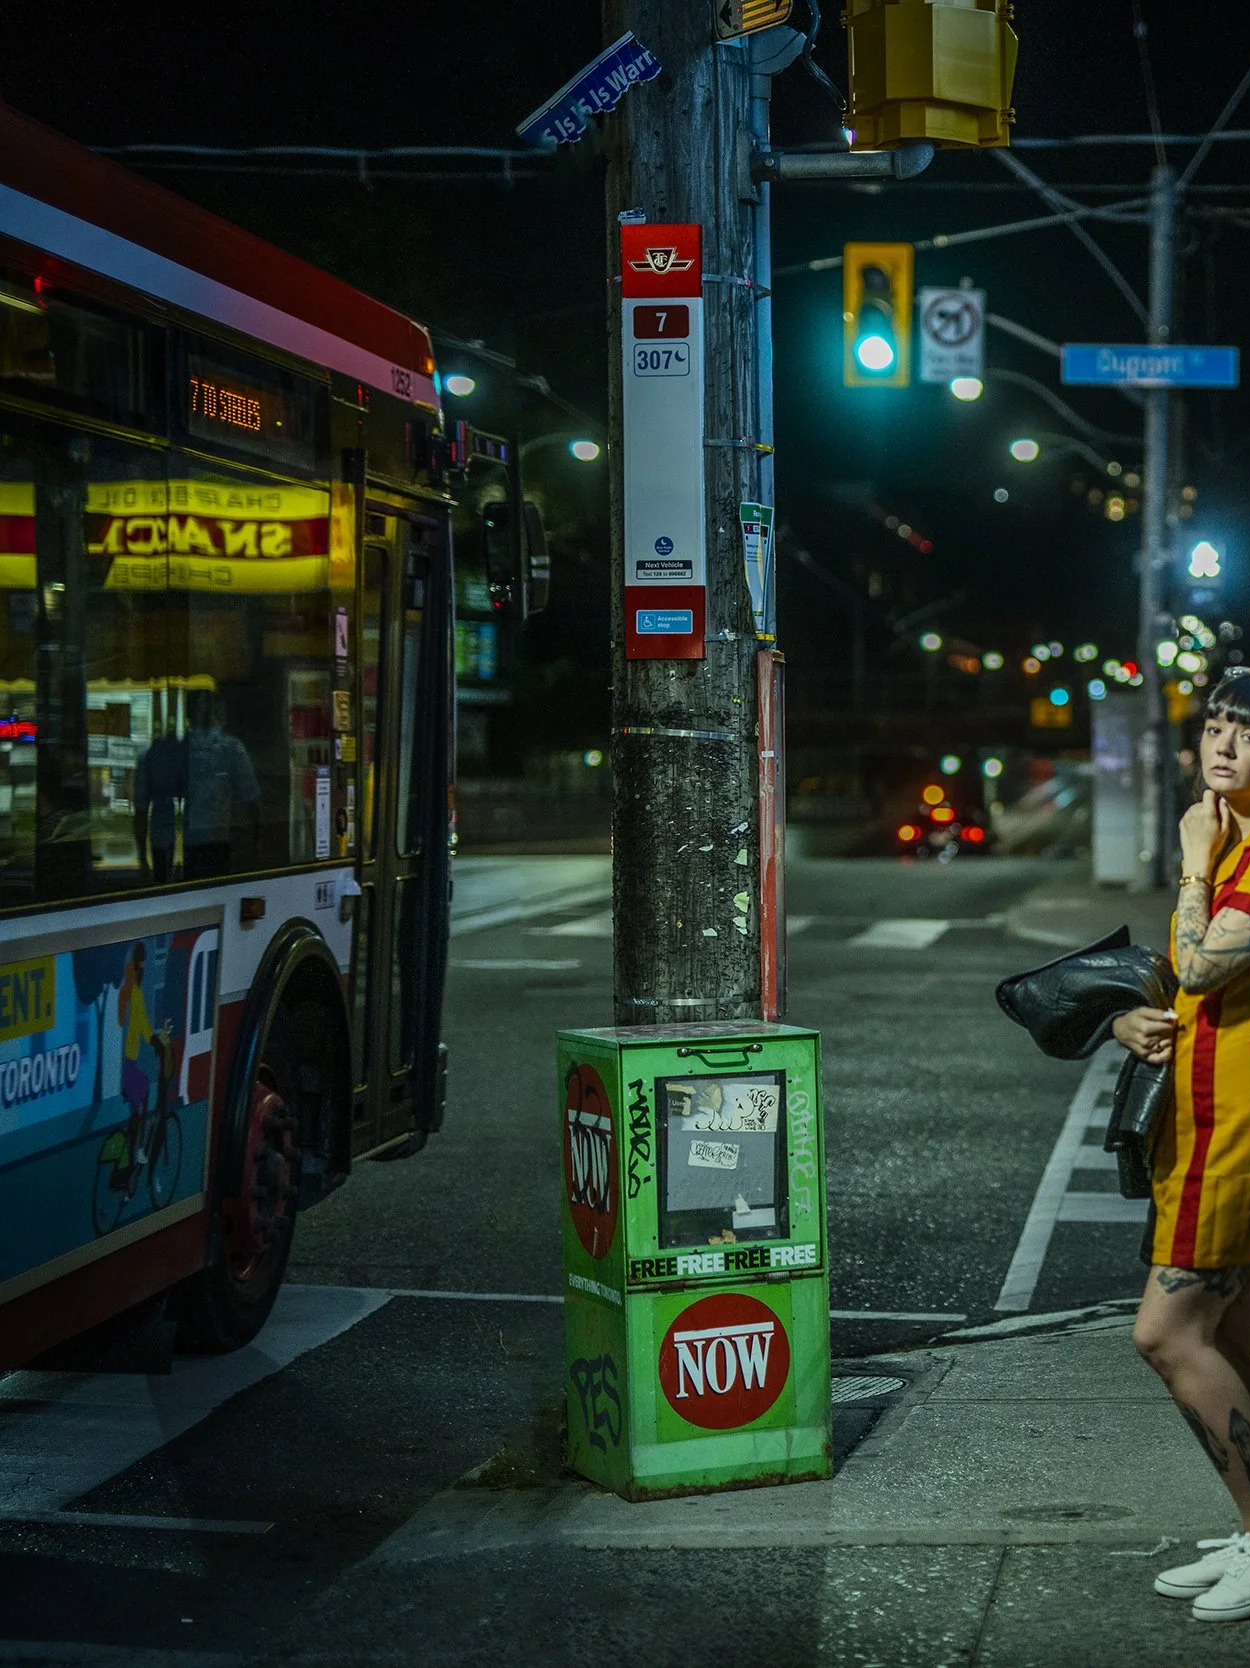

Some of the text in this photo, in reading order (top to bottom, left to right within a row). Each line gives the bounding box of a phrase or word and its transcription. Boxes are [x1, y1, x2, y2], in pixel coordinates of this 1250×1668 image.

[655, 312, 668, 332] 7
[637, 350, 673, 370] 307
[390, 367, 412, 397] 1252
[190, 379, 199, 411] 7
[202, 383, 216, 416] TO
[674, 1332, 775, 1398] NOW
